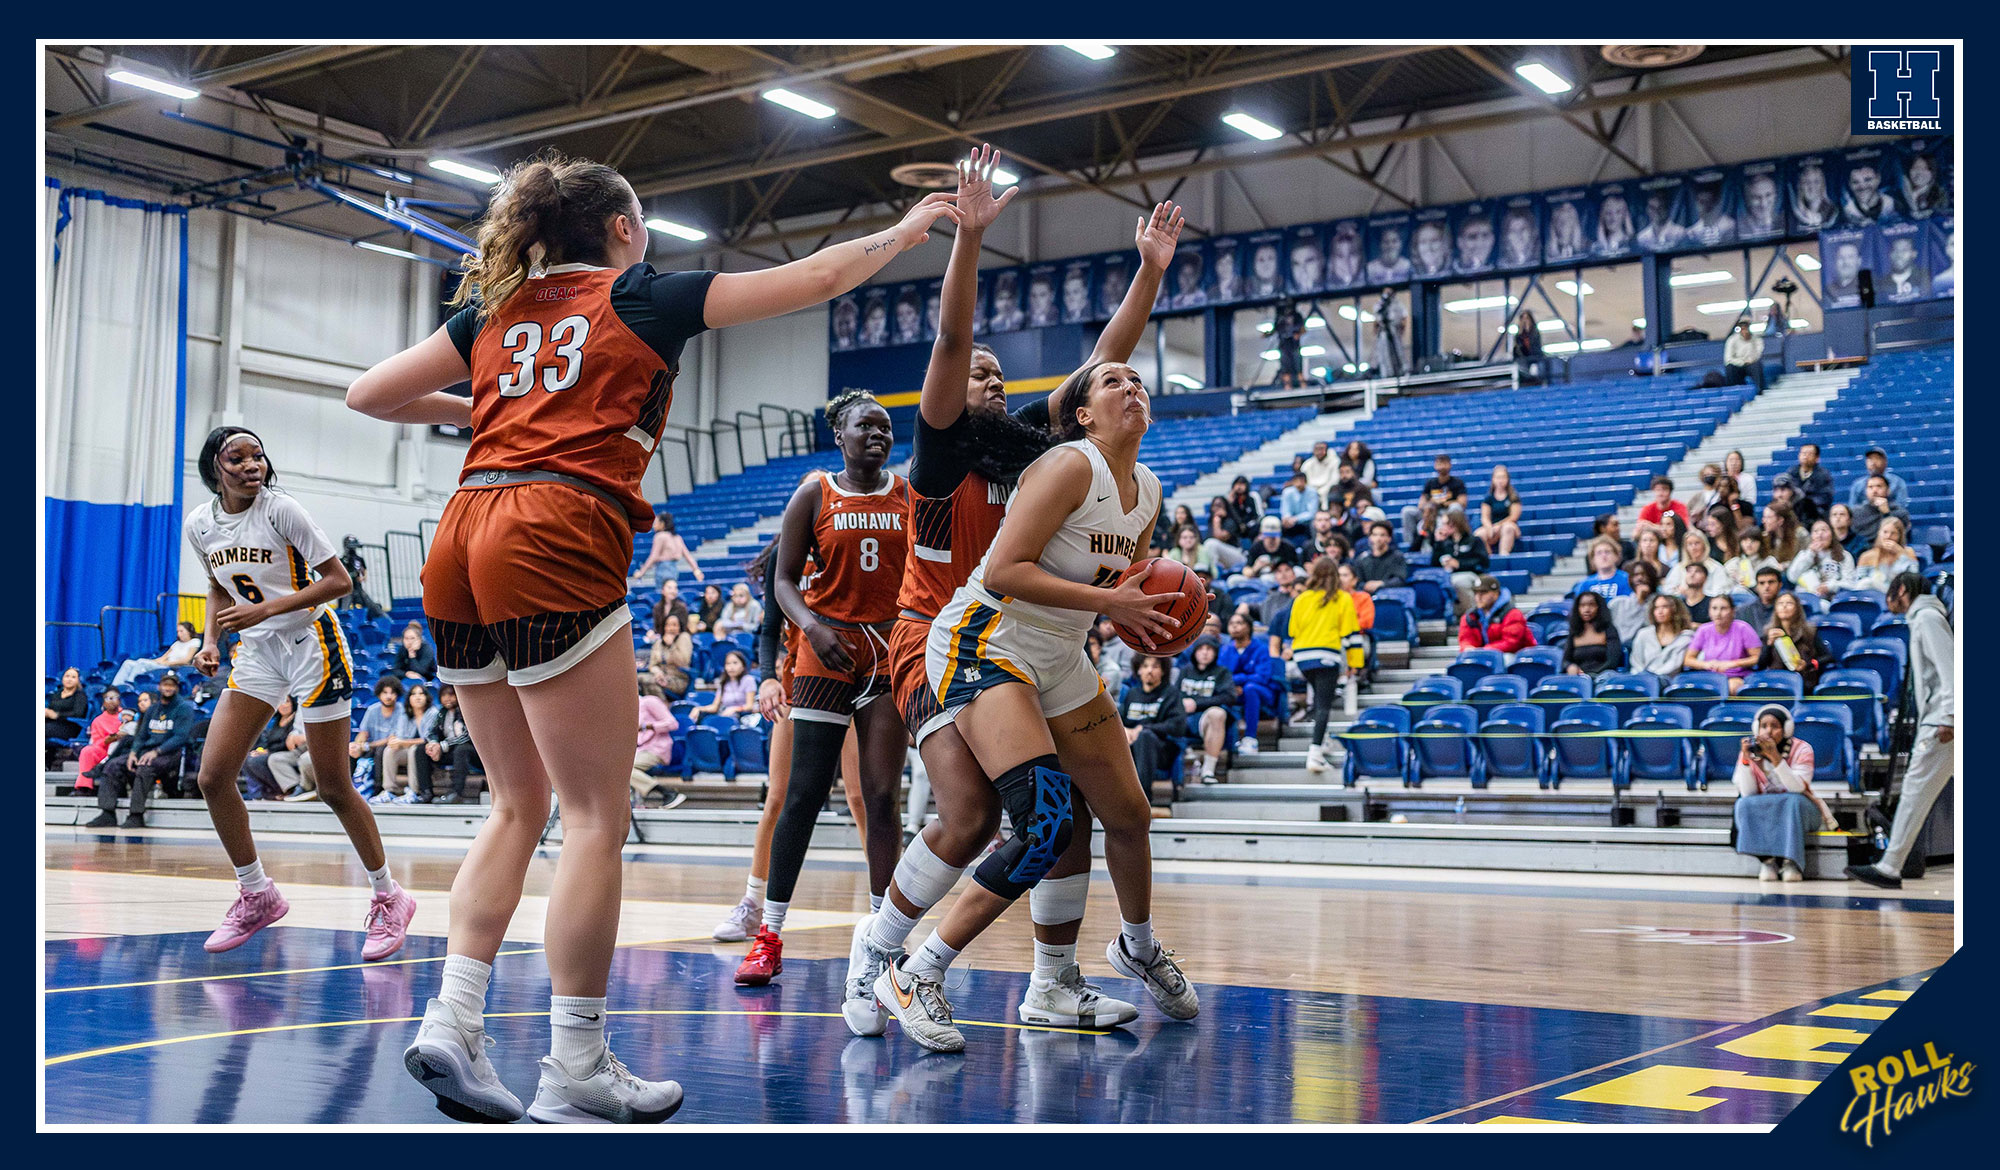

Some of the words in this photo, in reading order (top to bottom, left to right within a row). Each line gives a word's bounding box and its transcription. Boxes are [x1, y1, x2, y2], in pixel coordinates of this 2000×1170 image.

[535, 286, 578, 301] OCAA
[498, 314, 591, 399] 33
[833, 512, 903, 531] MOHAWK
[209, 546, 273, 569] HUMBER
[859, 537, 880, 573] 8
[230, 572, 266, 605] 6
